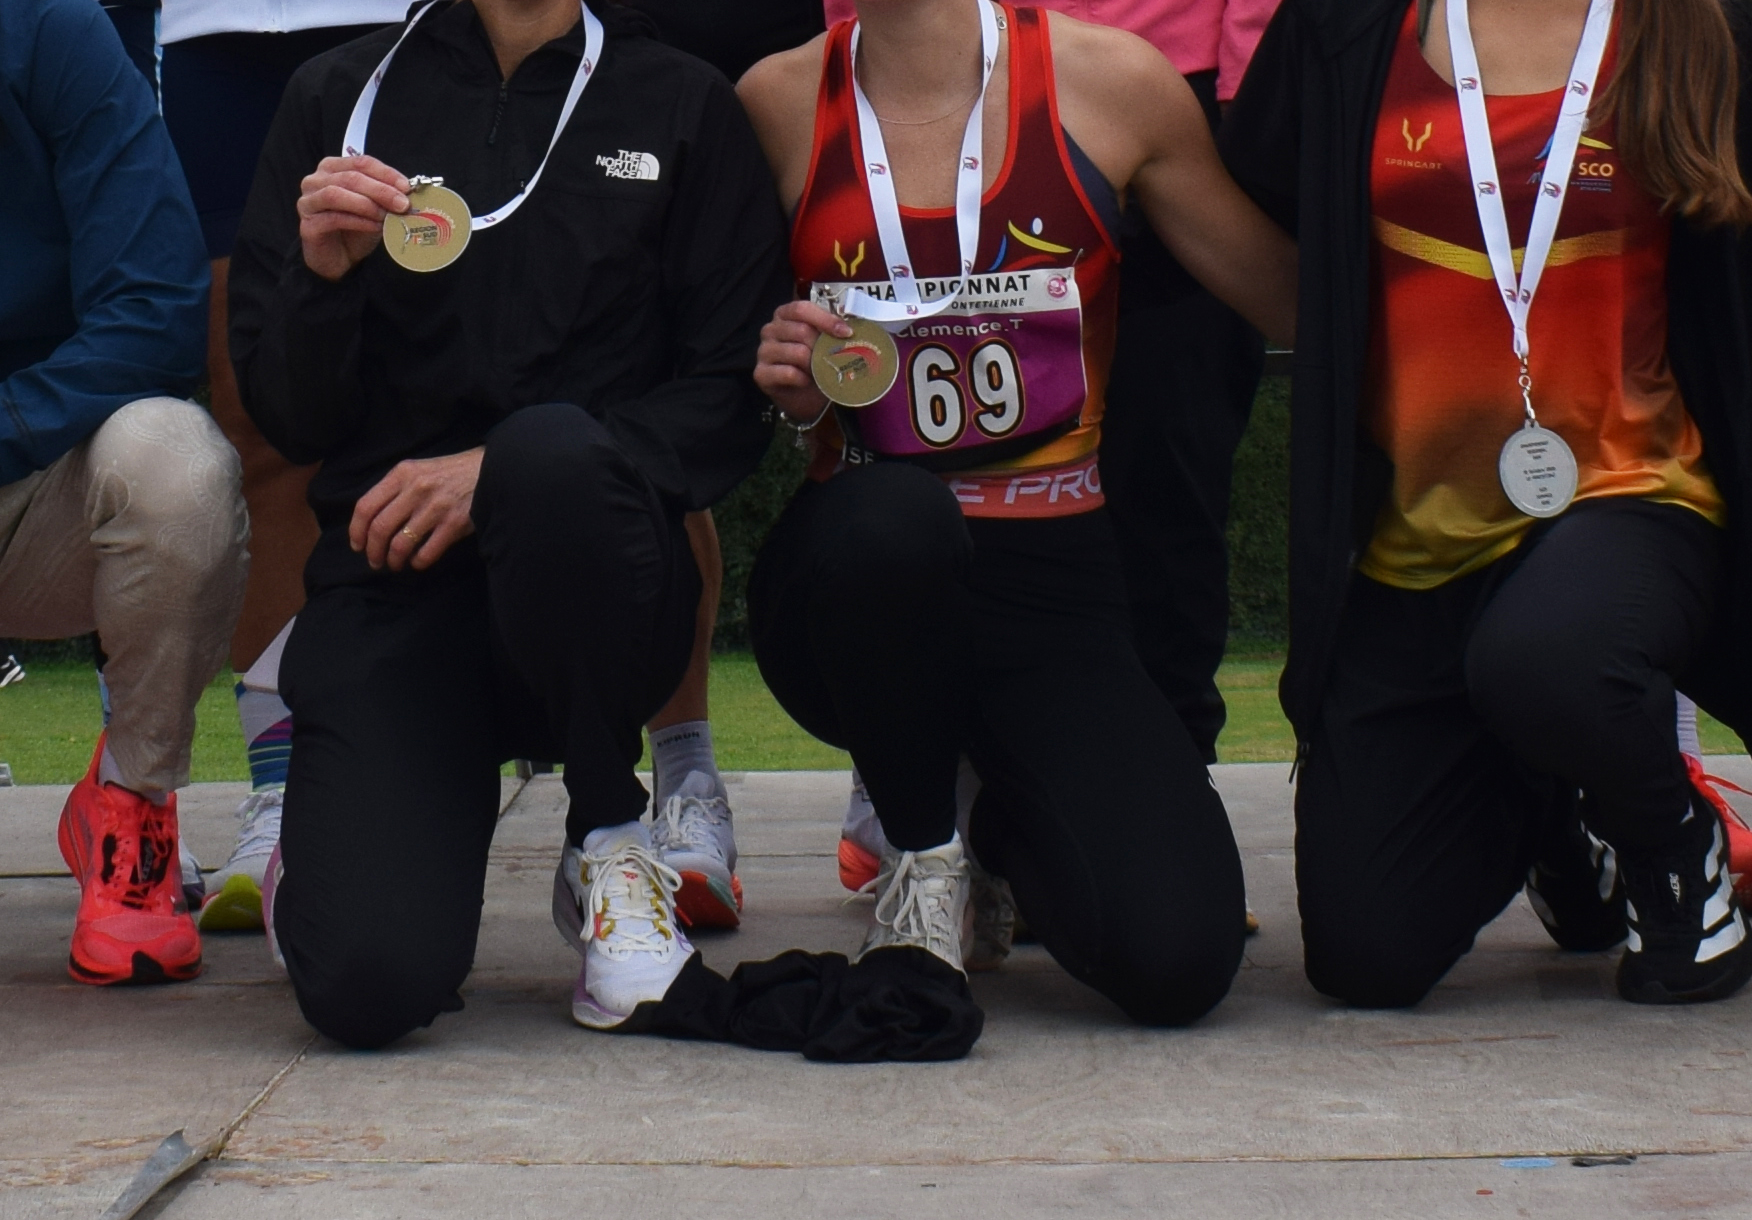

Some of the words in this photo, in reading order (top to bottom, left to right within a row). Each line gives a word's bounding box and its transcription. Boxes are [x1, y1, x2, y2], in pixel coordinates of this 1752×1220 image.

[618, 149, 641, 161] THE
[596, 155, 640, 170] NORTH
[1578, 162, 1614, 177] SCO
[605, 168, 638, 179] FACE
[950, 297, 1025, 311] ONTETIENNE
[906, 338, 1026, 449] 69
